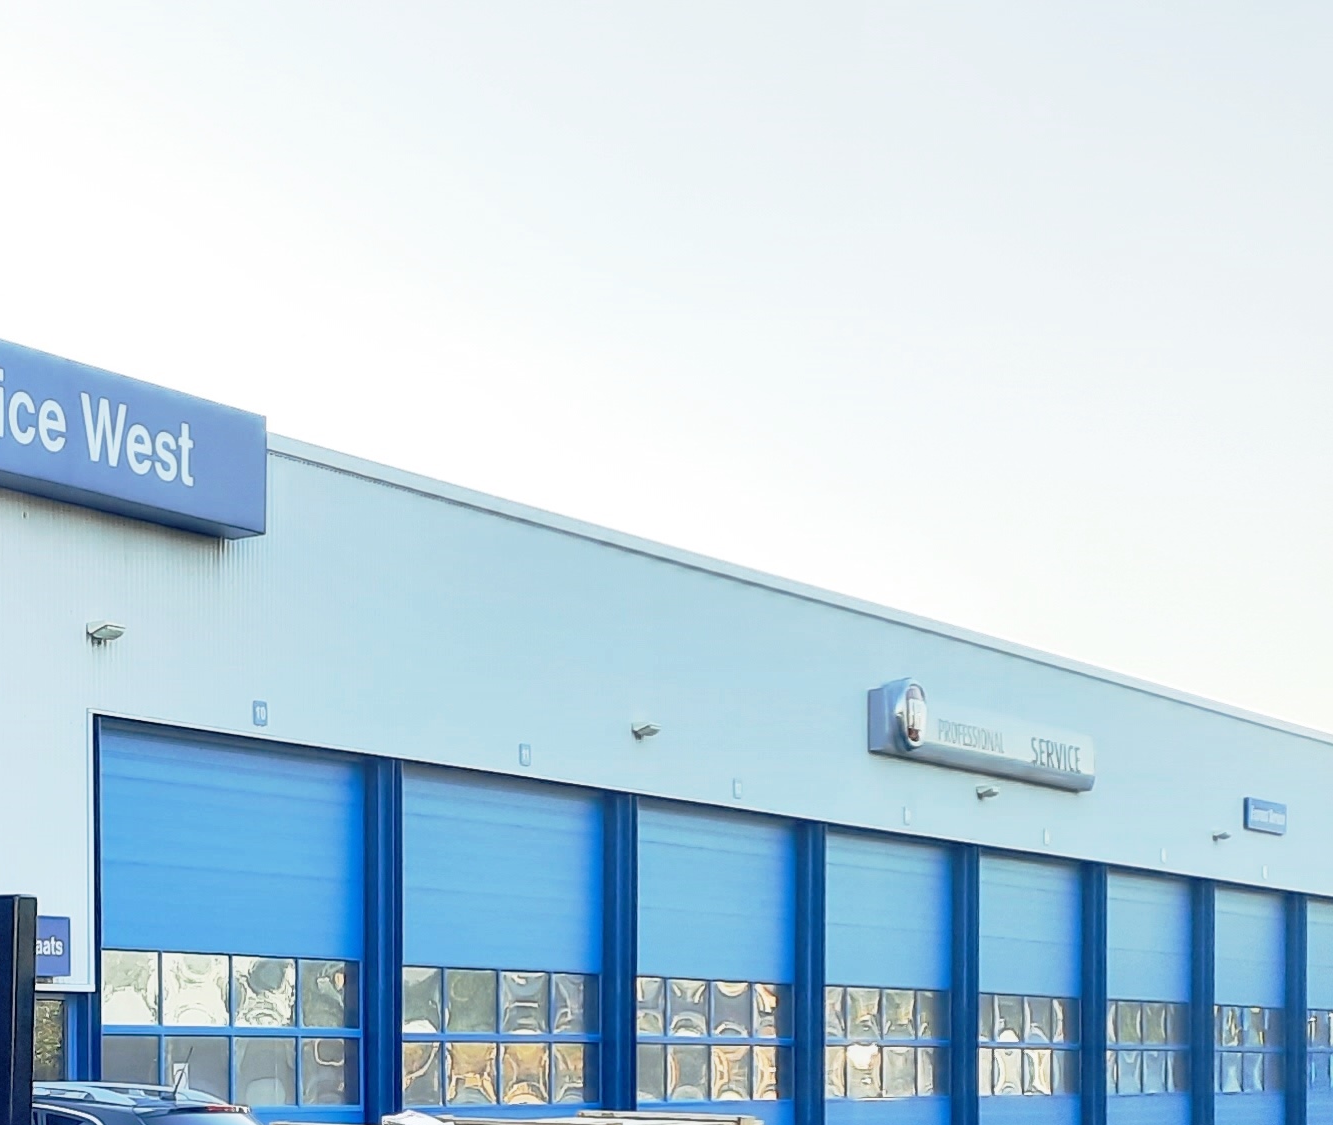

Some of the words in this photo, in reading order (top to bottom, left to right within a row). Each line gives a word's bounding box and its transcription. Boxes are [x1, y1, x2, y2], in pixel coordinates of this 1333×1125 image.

[80, 392, 195, 487] West
[938, 719, 1004, 753] PROFESSIONAL
[1030, 736, 1081, 774] SERVICE
